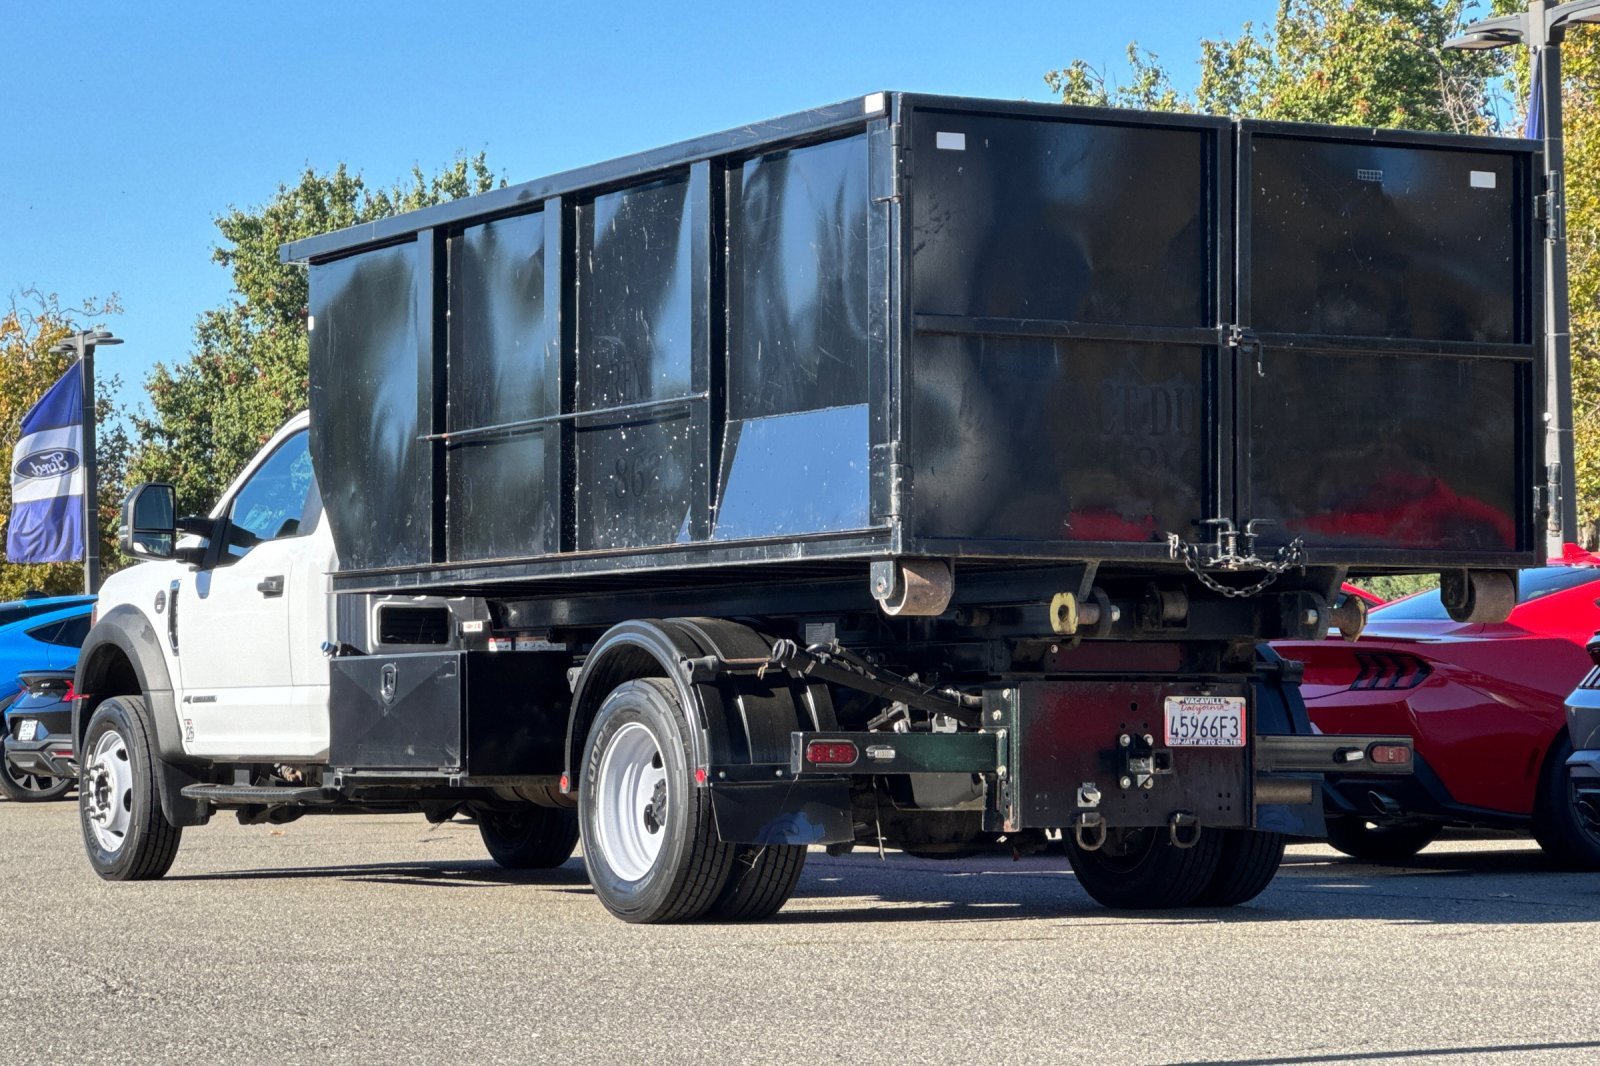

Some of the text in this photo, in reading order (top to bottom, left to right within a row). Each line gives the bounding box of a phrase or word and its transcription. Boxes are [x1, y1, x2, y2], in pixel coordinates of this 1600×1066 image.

[1184, 697, 1226, 705] VACAVILLE
[1180, 704, 1229, 715] California
[1170, 715, 1239, 738] 45966F3
